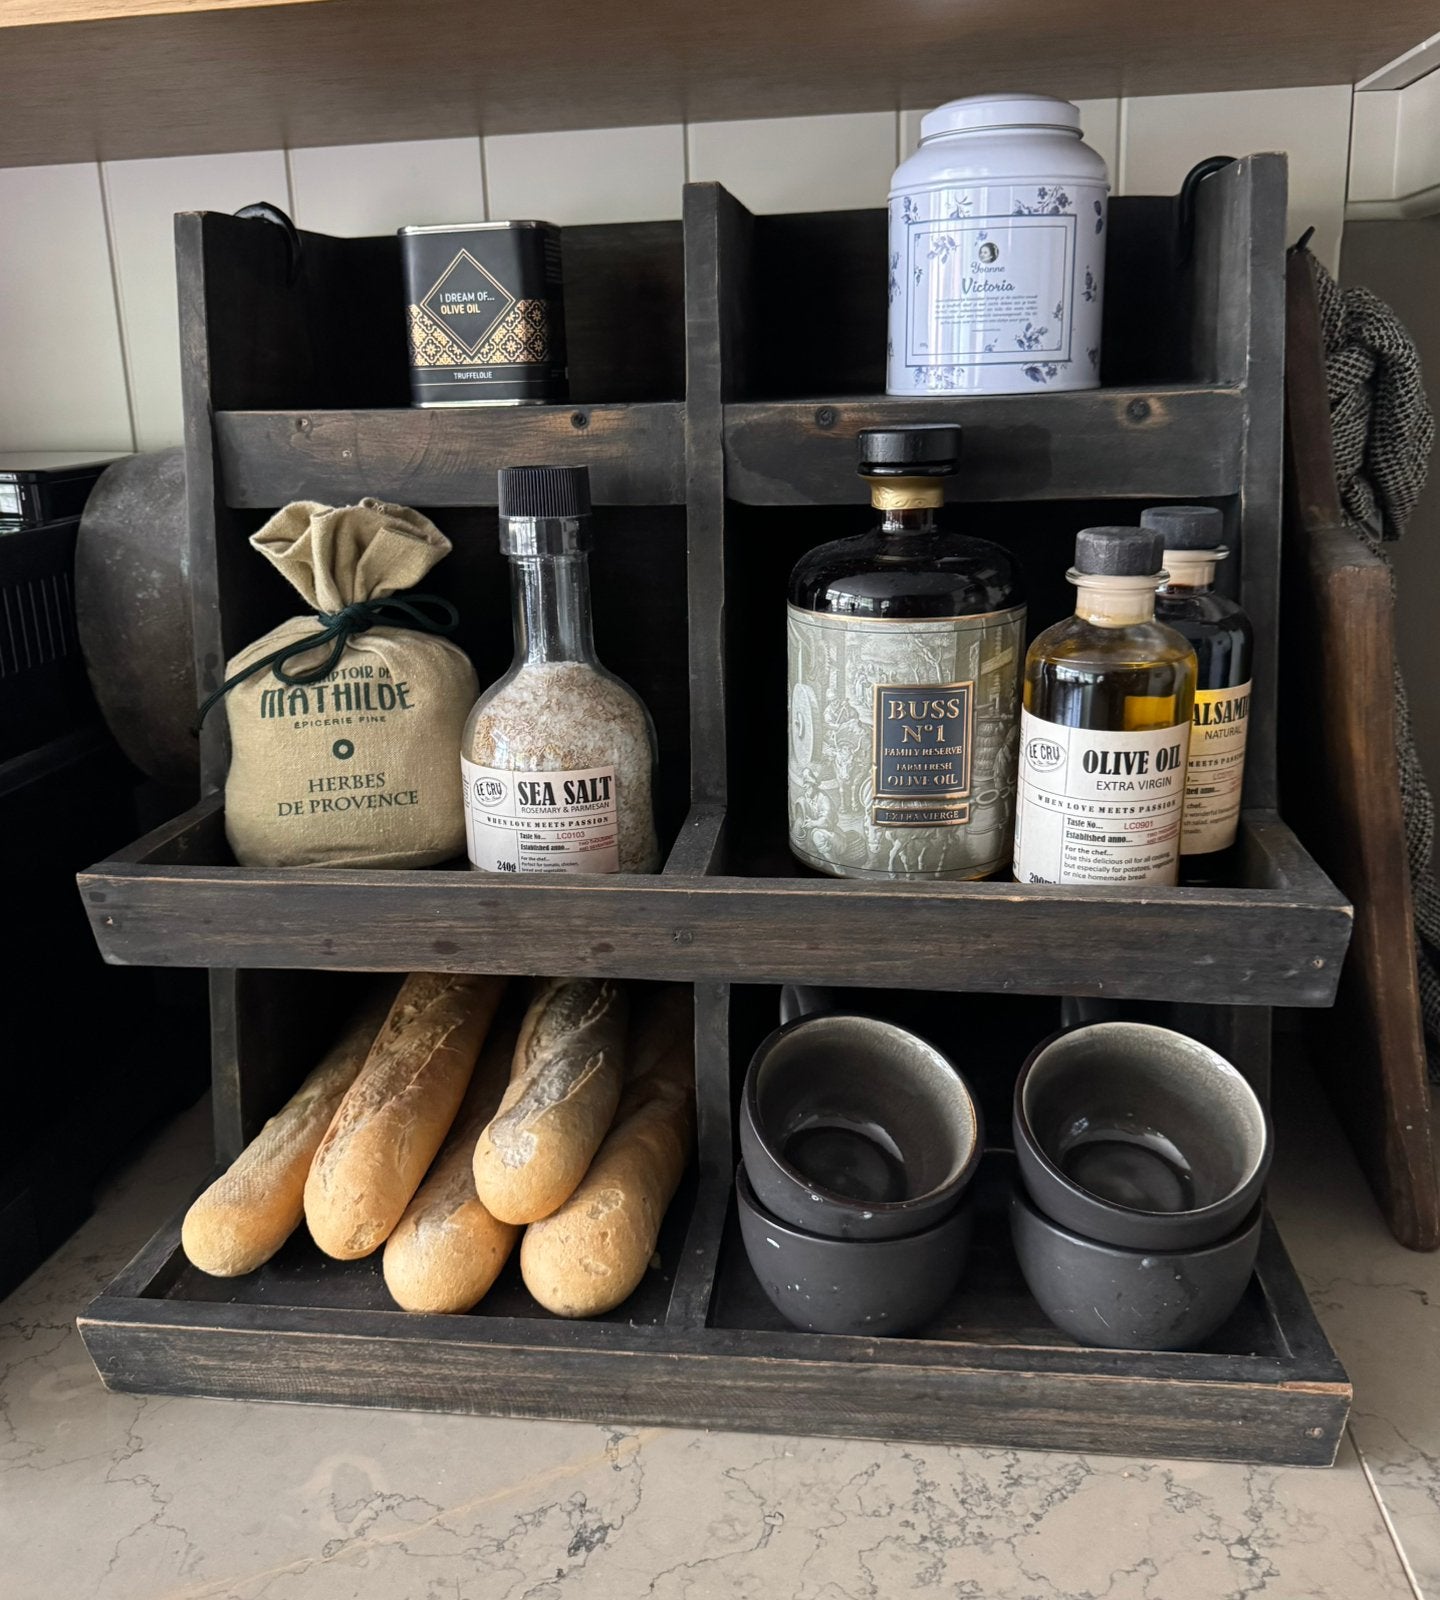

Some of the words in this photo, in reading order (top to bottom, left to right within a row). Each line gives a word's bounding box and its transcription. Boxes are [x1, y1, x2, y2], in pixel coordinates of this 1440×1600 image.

[962, 277, 1015, 294] Victoria
[445, 292, 475, 303] DREAM
[477, 291, 495, 301] OF...
[441, 304, 465, 315] OLIVE
[467, 303, 480, 314] OIL
[453, 371, 493, 380] TRUFFELOLIE
[261, 681, 415, 719] MATHILDE
[887, 698, 960, 719] BUSS
[359, 715, 387, 723] FINE
[884, 747, 920, 756] FAMILY
[922, 745, 963, 756] RESERVE
[1029, 743, 1037, 758] LE
[1040, 744, 1060, 760] CRU
[1083, 749, 1149, 775] OLIVE
[1156, 744, 1181, 772] OIL
[1188, 759, 1218, 767] MEETS
[896, 763, 921, 771] FARM
[924, 762, 952, 771] FRESH
[308, 771, 386, 793] HERBES
[887, 775, 930, 786] OLIVE
[933, 773, 958, 785] OIL
[1096, 780, 1135, 791] EXTRA
[1138, 776, 1172, 790] VIRGIN
[476, 782, 485, 796] LE
[486, 782, 503, 796] CRU
[517, 781, 557, 806] SEA
[563, 775, 612, 805] SALT
[277, 800, 304, 817] DE
[309, 790, 419, 814] PROVENCE
[521, 806, 561, 814] ROSEMARY
[563, 806, 569, 814] &
[571, 802, 610, 813] PARMESAN
[1037, 793, 1063, 807] WHEN
[1067, 802, 1095, 813] LOVE
[1098, 806, 1136, 814] MEETS
[885, 812, 919, 820] EXTRA
[922, 810, 959, 820] VIERGE
[487, 816, 508, 826] WHEN
[510, 820, 532, 828] LOVE
[568, 816, 609, 827] PASSION
[1067, 817, 1085, 828] Taste
[1123, 820, 1154, 831] LC0901
[520, 832, 533, 840] Taste
[556, 831, 586, 840] LC0103
[1066, 830, 1106, 842] Established
[520, 843, 549, 851] Established
[1065, 844, 1077, 852] For
[497, 860, 516, 872] 240g
[1064, 861, 1075, 869] but
[1077, 865, 1110, 873] especially
[1072, 871, 1086, 879] nice
[1088, 873, 1126, 881] homemade
